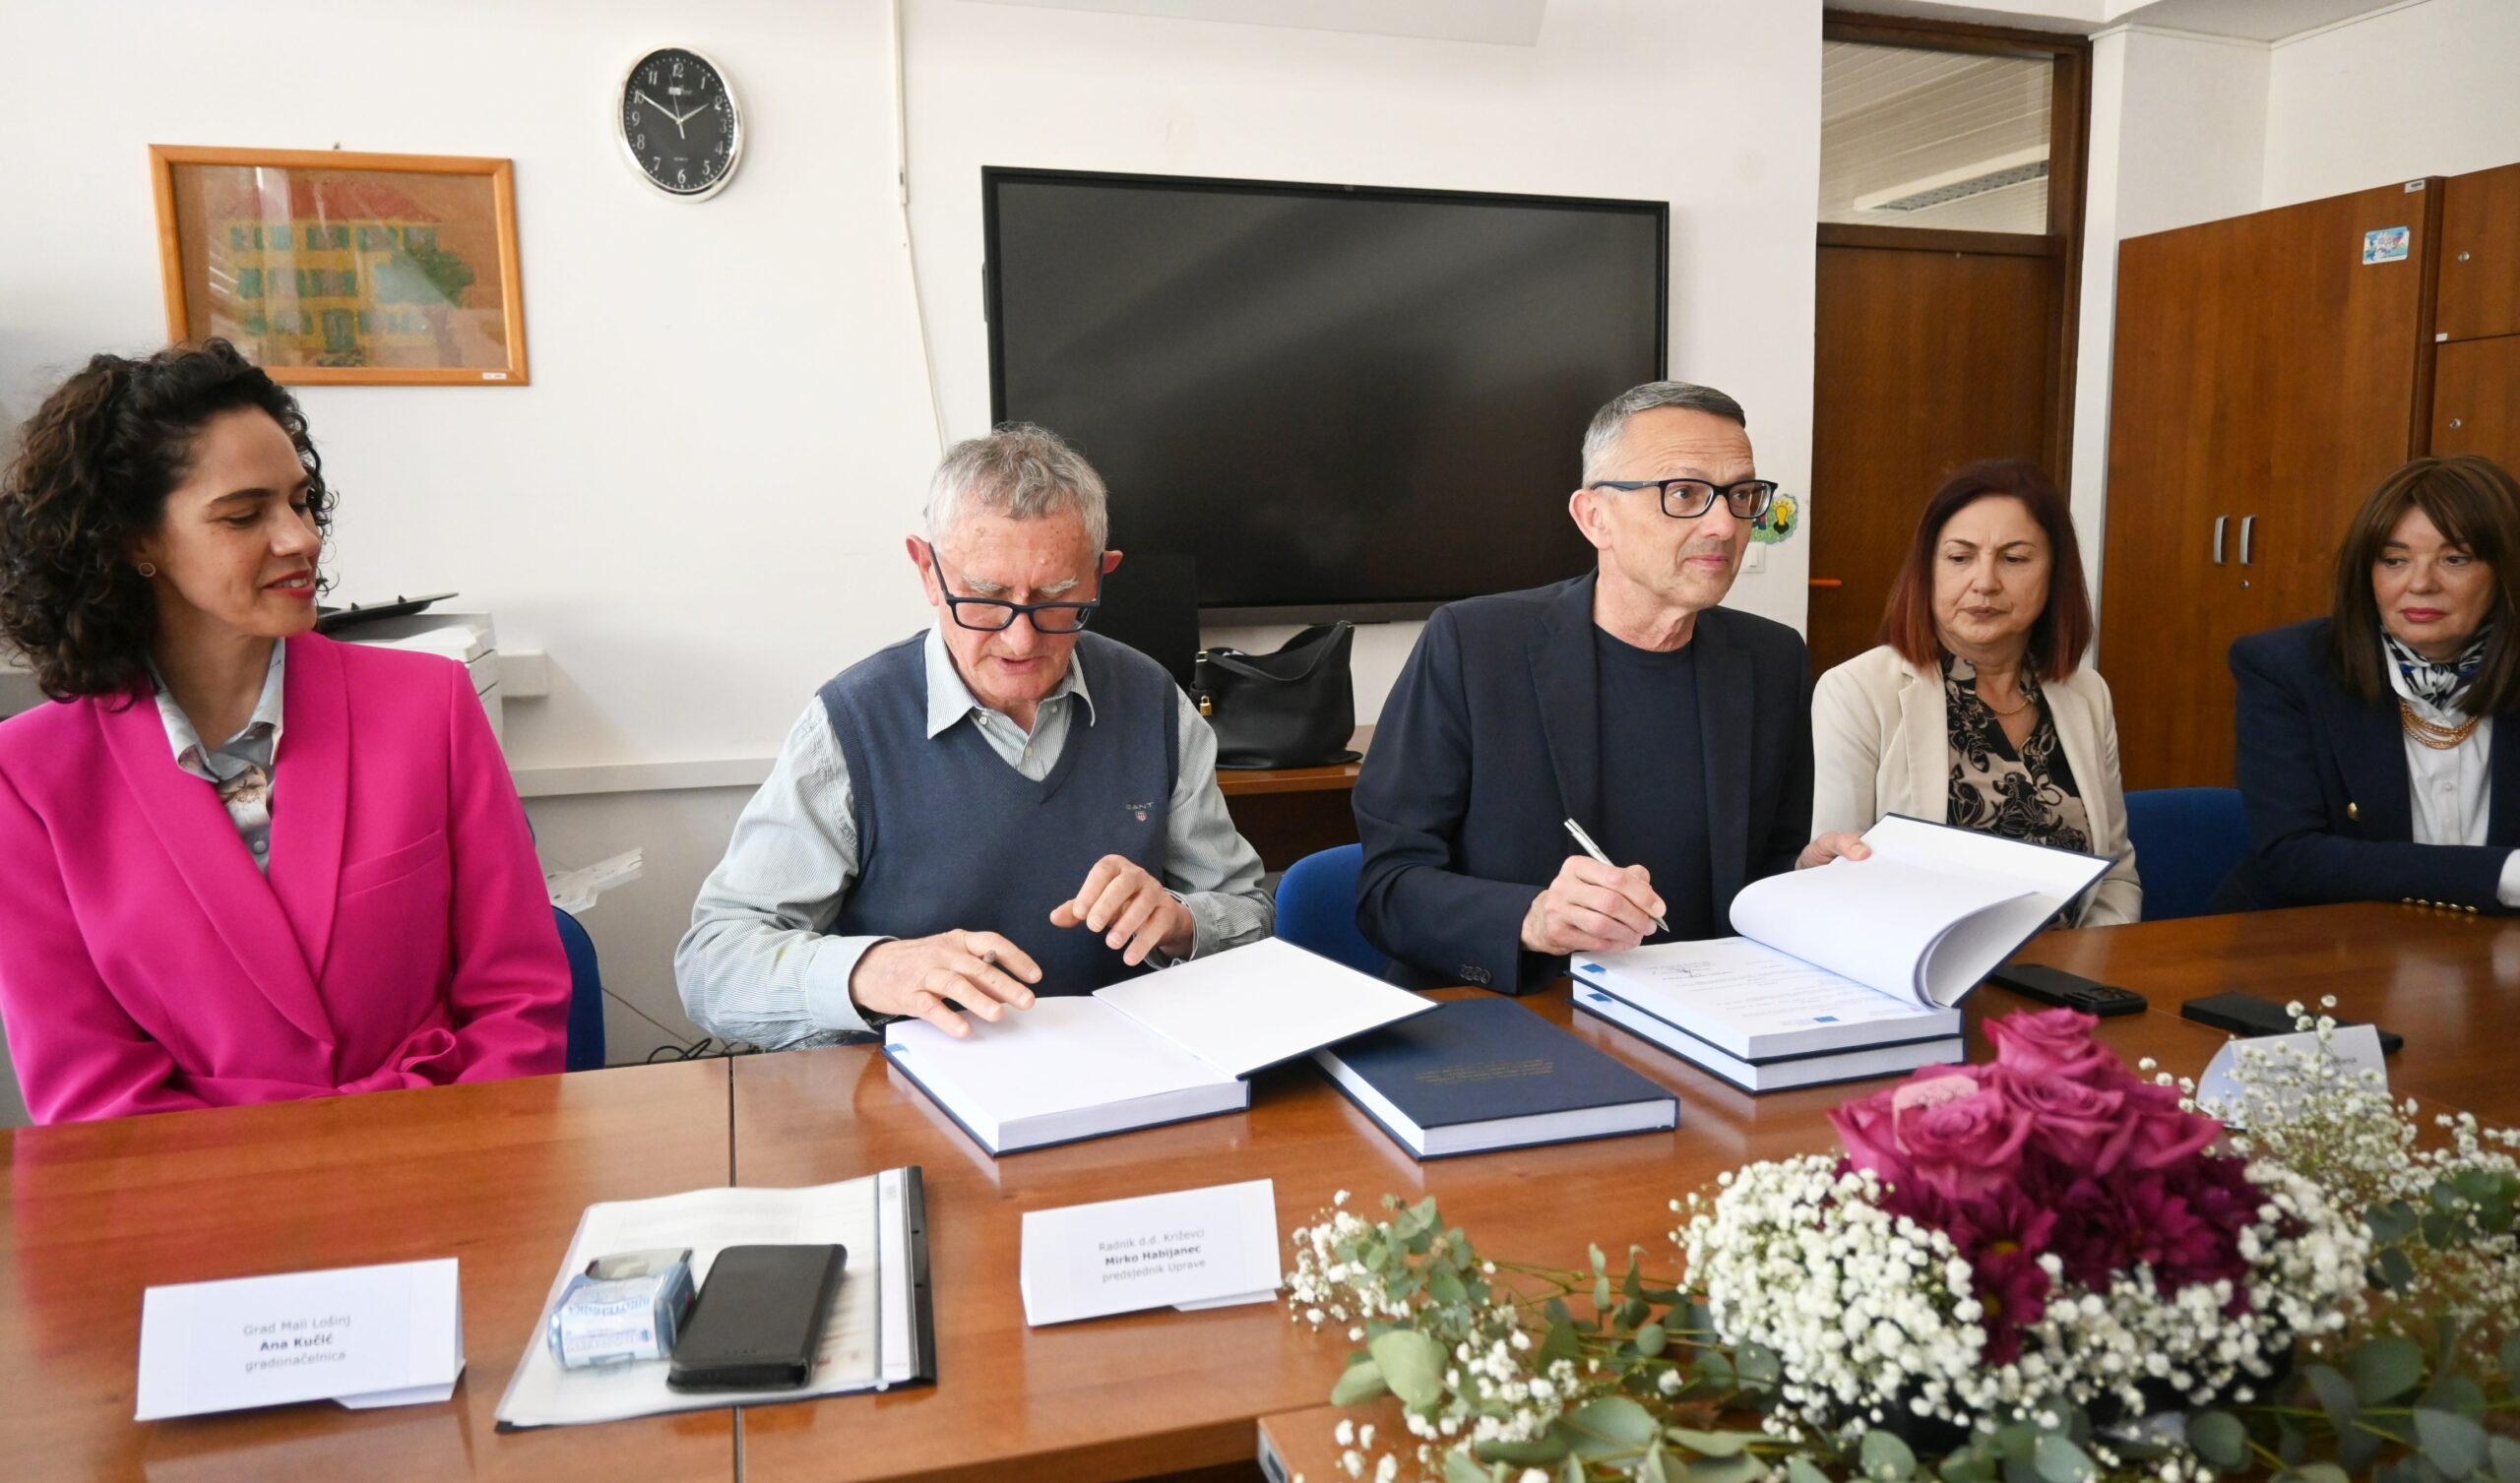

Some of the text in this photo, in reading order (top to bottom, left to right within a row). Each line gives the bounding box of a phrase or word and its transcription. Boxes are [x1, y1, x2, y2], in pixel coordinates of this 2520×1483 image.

[672, 63, 684, 78] 12
[649, 71, 658, 86] 11
[701, 76, 706, 91] 1
[714, 95, 723, 110] 2
[632, 111, 640, 126] 9
[720, 118, 727, 133] 3
[637, 134, 645, 150] 8
[715, 141, 723, 155] 4
[653, 156, 661, 171] 7
[702, 160, 710, 175] 5
[678, 169, 686, 184] 6
[1099, 1238, 1135, 1252] Radnik
[1164, 1228, 1205, 1242] Križevci
[1104, 1245, 1202, 1266] Mirko Habijanec
[1102, 1260, 1206, 1283] predsjednik Uprave
[243, 1315, 351, 1336] Grad Mali Lošinj
[260, 1332, 334, 1351] Ana Kučić
[245, 1351, 346, 1374] gradonačelnica
